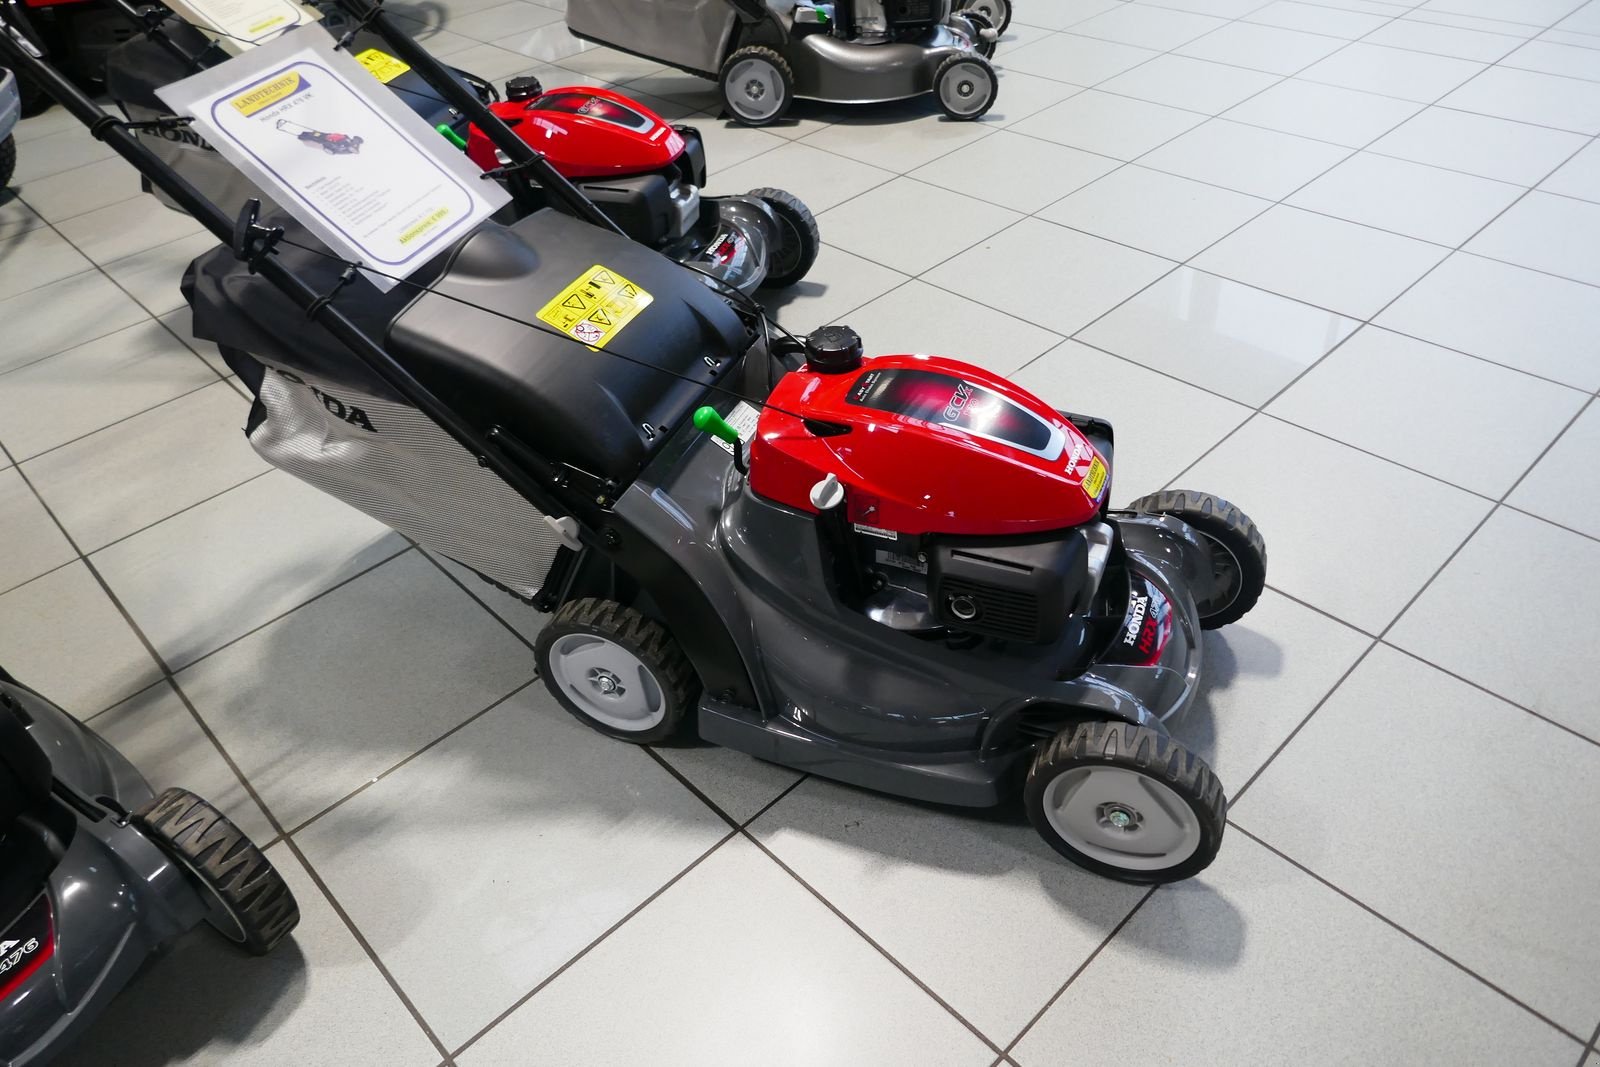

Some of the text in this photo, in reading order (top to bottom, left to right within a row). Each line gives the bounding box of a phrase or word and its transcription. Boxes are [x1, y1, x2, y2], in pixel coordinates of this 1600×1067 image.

[235, 77, 296, 109] LANDTECHNIK
[705, 233, 728, 255] HONDA
[1064, 444, 1083, 475] HONDA
[1123, 596, 1148, 646] HONDA
[1138, 617, 1158, 654] HRX
